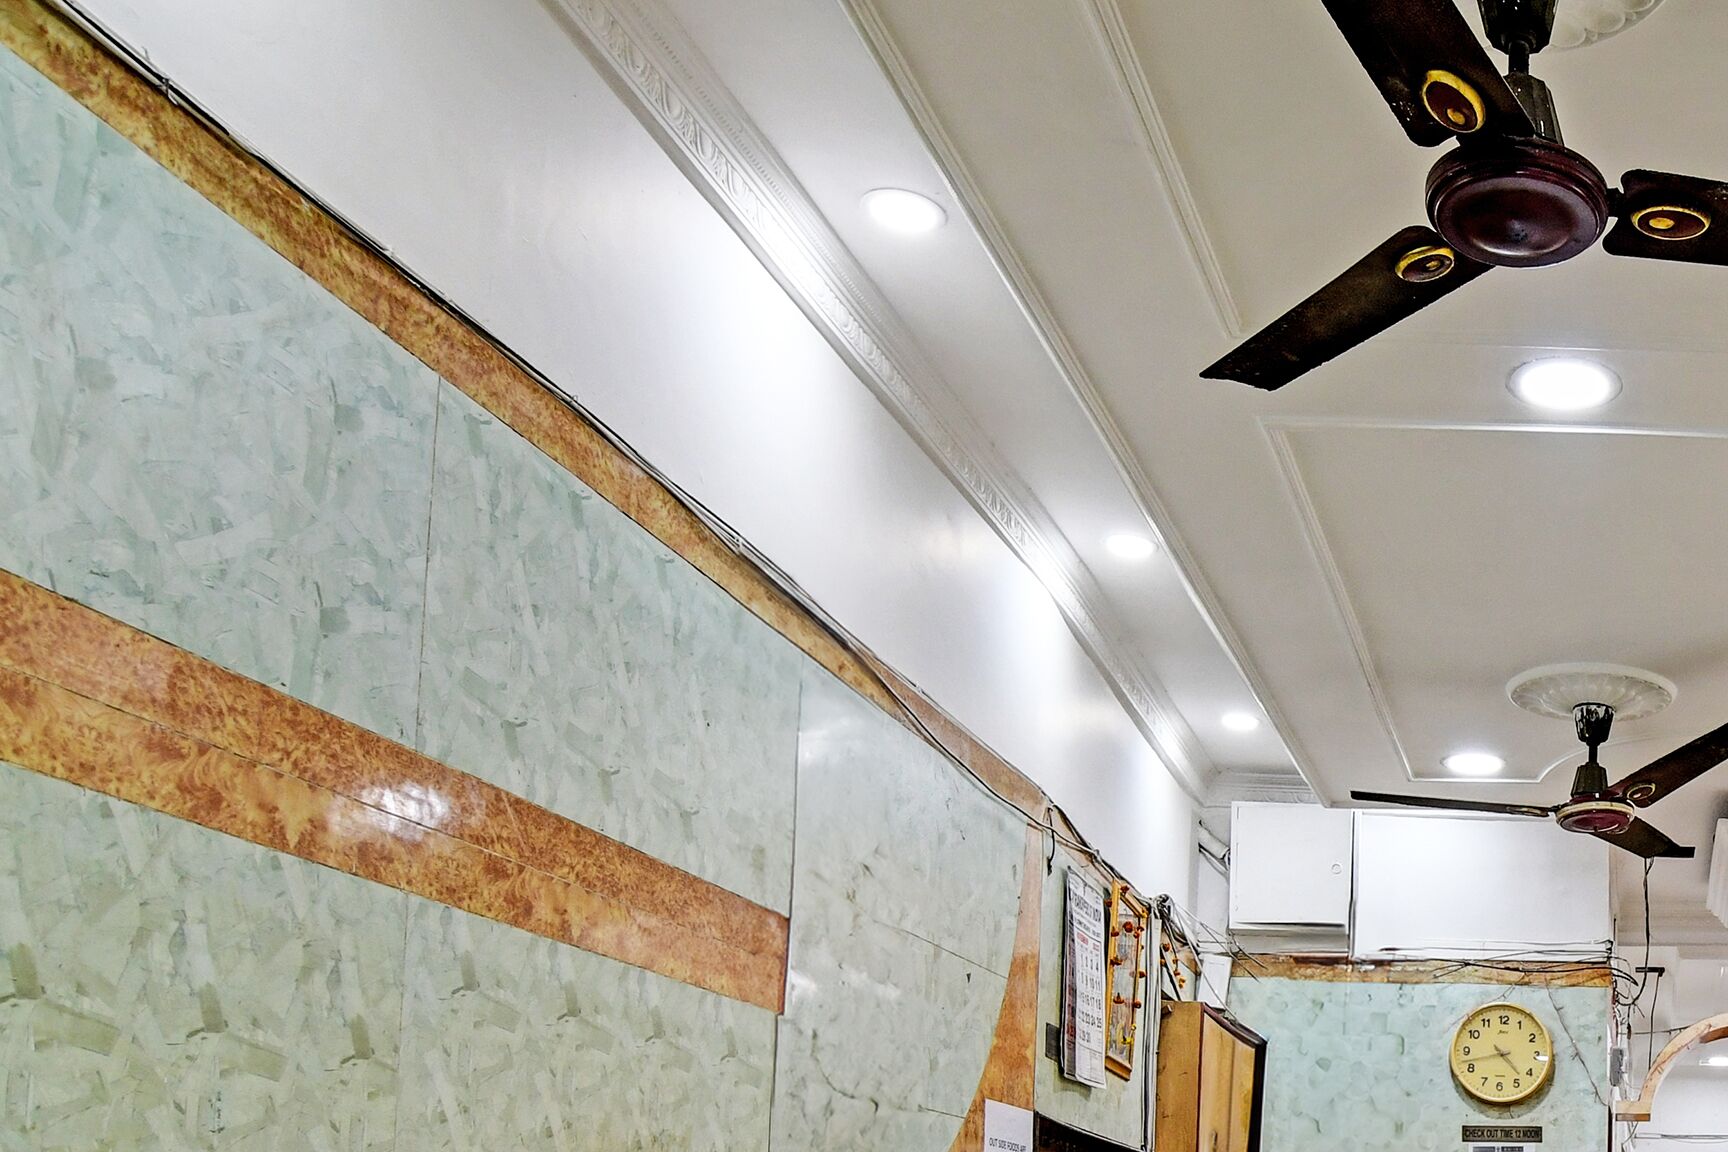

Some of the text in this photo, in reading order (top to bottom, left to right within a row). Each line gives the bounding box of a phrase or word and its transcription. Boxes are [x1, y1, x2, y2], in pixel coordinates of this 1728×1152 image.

[1481, 1018, 1490, 1028] 11
[1499, 1015, 1510, 1025] 12
[1517, 1021, 1522, 1030] 1
[1468, 1029, 1480, 1039] 10
[1529, 1033, 1536, 1043] 2
[1463, 1046, 1471, 1055] 9
[1533, 1051, 1540, 1060] 3
[1467, 1063, 1475, 1073] 8
[1526, 1068, 1533, 1077] 4
[1481, 1077, 1488, 1086] 7
[1513, 1079, 1520, 1088] 5
[1496, 1082, 1504, 1091] 6
[1464, 1129, 1485, 1138] CHECK
[1486, 1129, 1499, 1138] OUT
[1499, 1129, 1513, 1138] TIME
[1515, 1129, 1521, 1138] 12
[989, 1137, 998, 1147] OUT
[998, 1139, 1007, 1150] SIDE
[1008, 1141, 1020, 1152] FOODS
